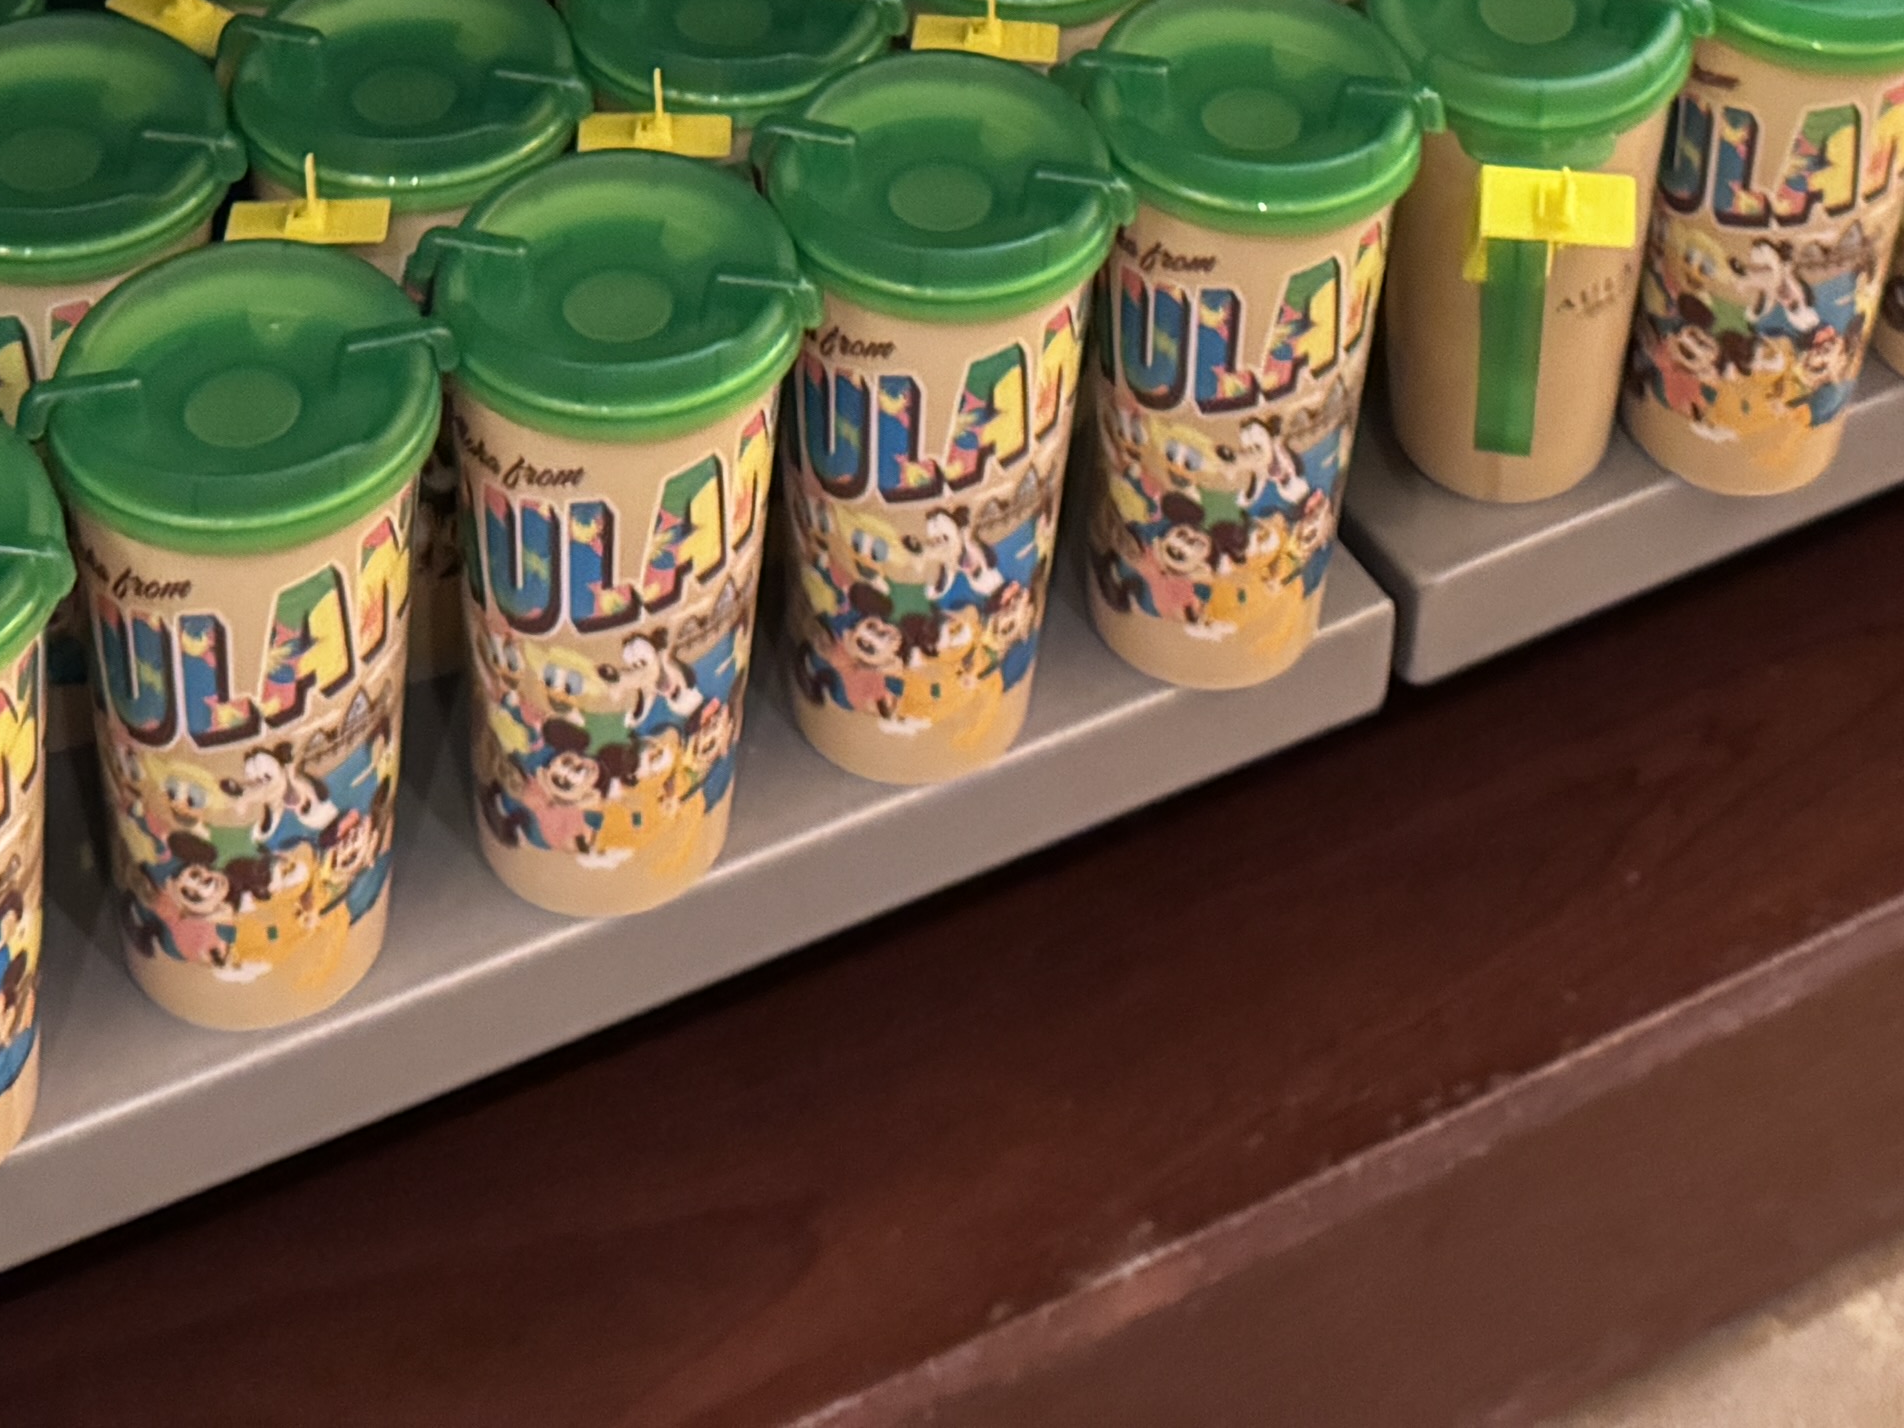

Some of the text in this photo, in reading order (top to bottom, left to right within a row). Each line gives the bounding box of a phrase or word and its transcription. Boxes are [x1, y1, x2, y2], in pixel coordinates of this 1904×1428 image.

[1140, 241, 1219, 273] from
[819, 326, 896, 360] from
[503, 455, 586, 489] from
[112, 567, 191, 601] from
